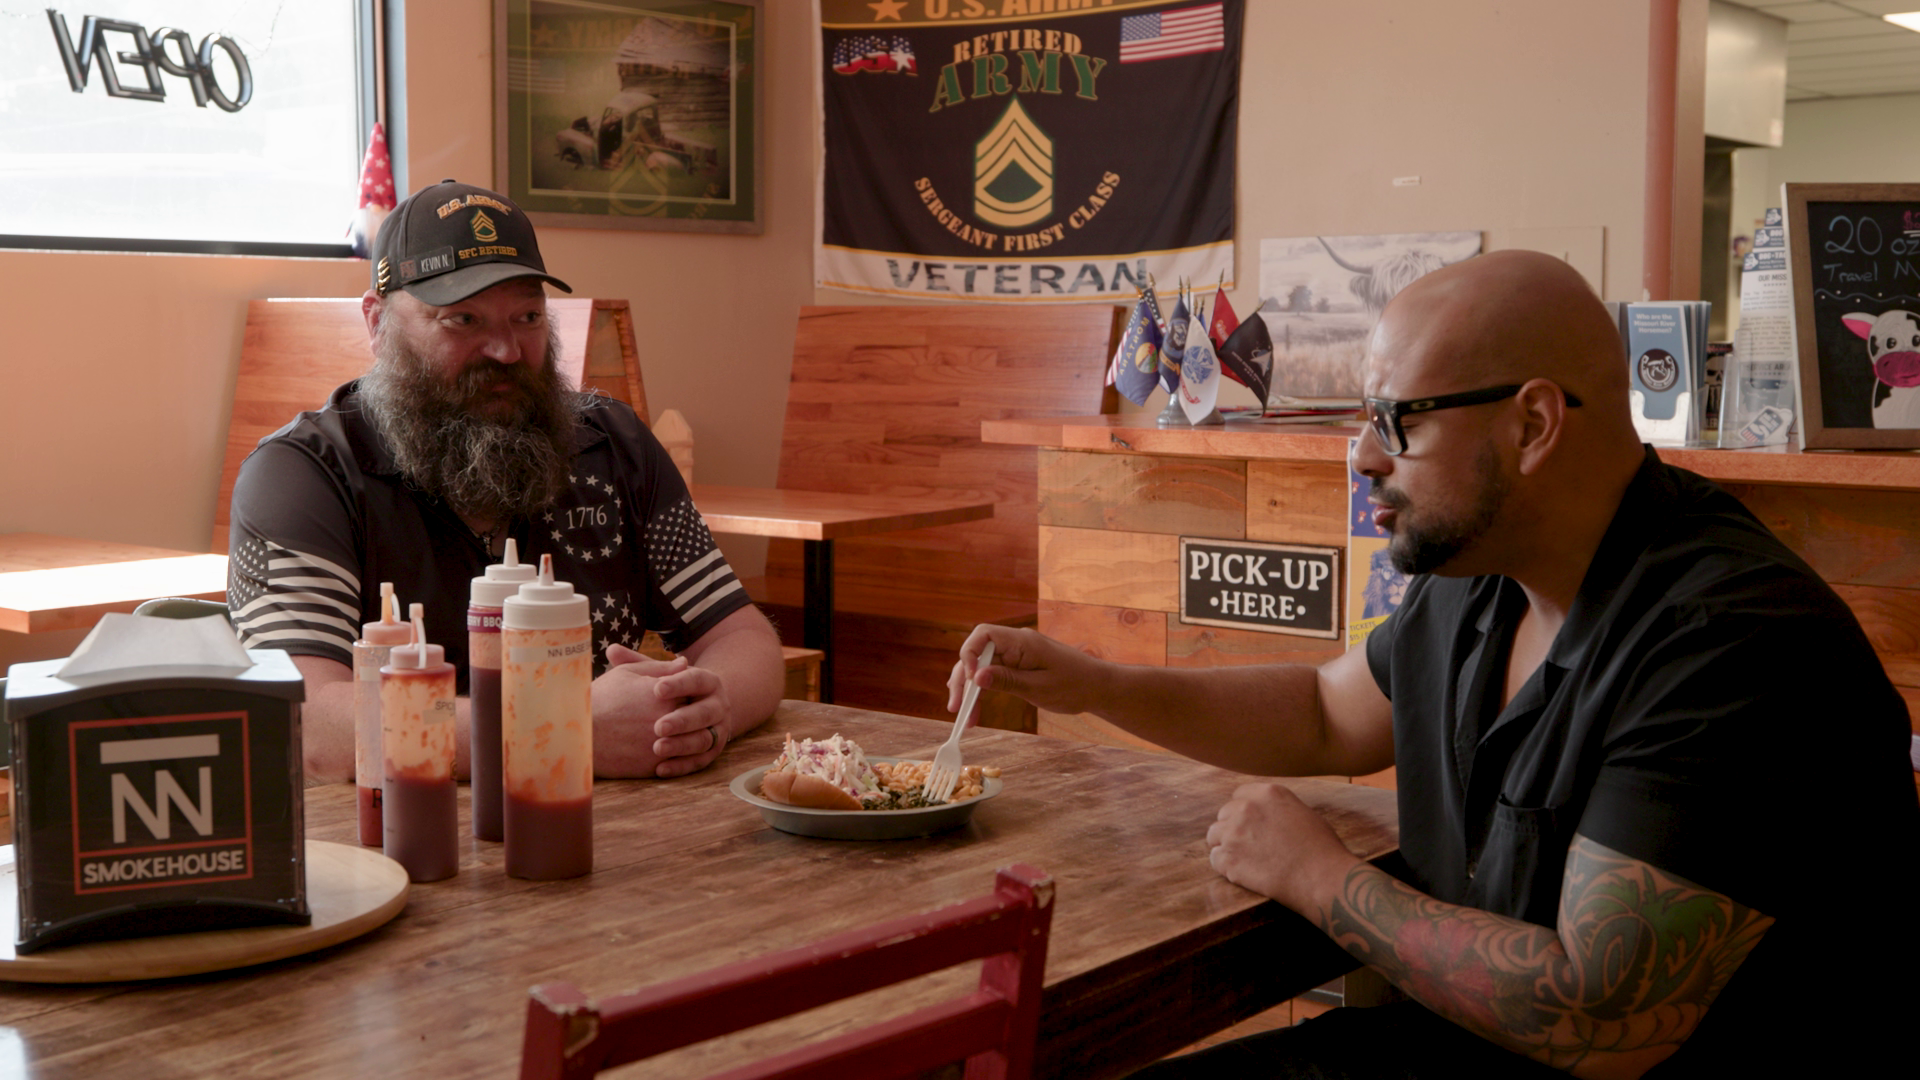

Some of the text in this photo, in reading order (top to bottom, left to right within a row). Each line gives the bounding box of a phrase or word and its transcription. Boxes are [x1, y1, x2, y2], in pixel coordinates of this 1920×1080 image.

[954, 29, 1082, 64] RETIRED
[929, 50, 1107, 113] ARMY
[914, 171, 1121, 251] SERGEANT FIRST CLASS
[1825, 215, 1882, 255] 20
[421, 256, 441, 273] KEVIN
[458, 246, 518, 259] SFC RETIRED
[886, 258, 1148, 294] VETERAN
[1758, 274, 1771, 282] OUR
[1823, 261, 1878, 282] Travel
[565, 505, 608, 530] 1776
[1189, 550, 1329, 591] PICK-UP
[483, 616, 502, 629] BBQ
[1350, 621, 1376, 631] TICKETS
[547, 648, 563, 658] NN
[84, 850, 244, 884] SMOKEHOUSE
